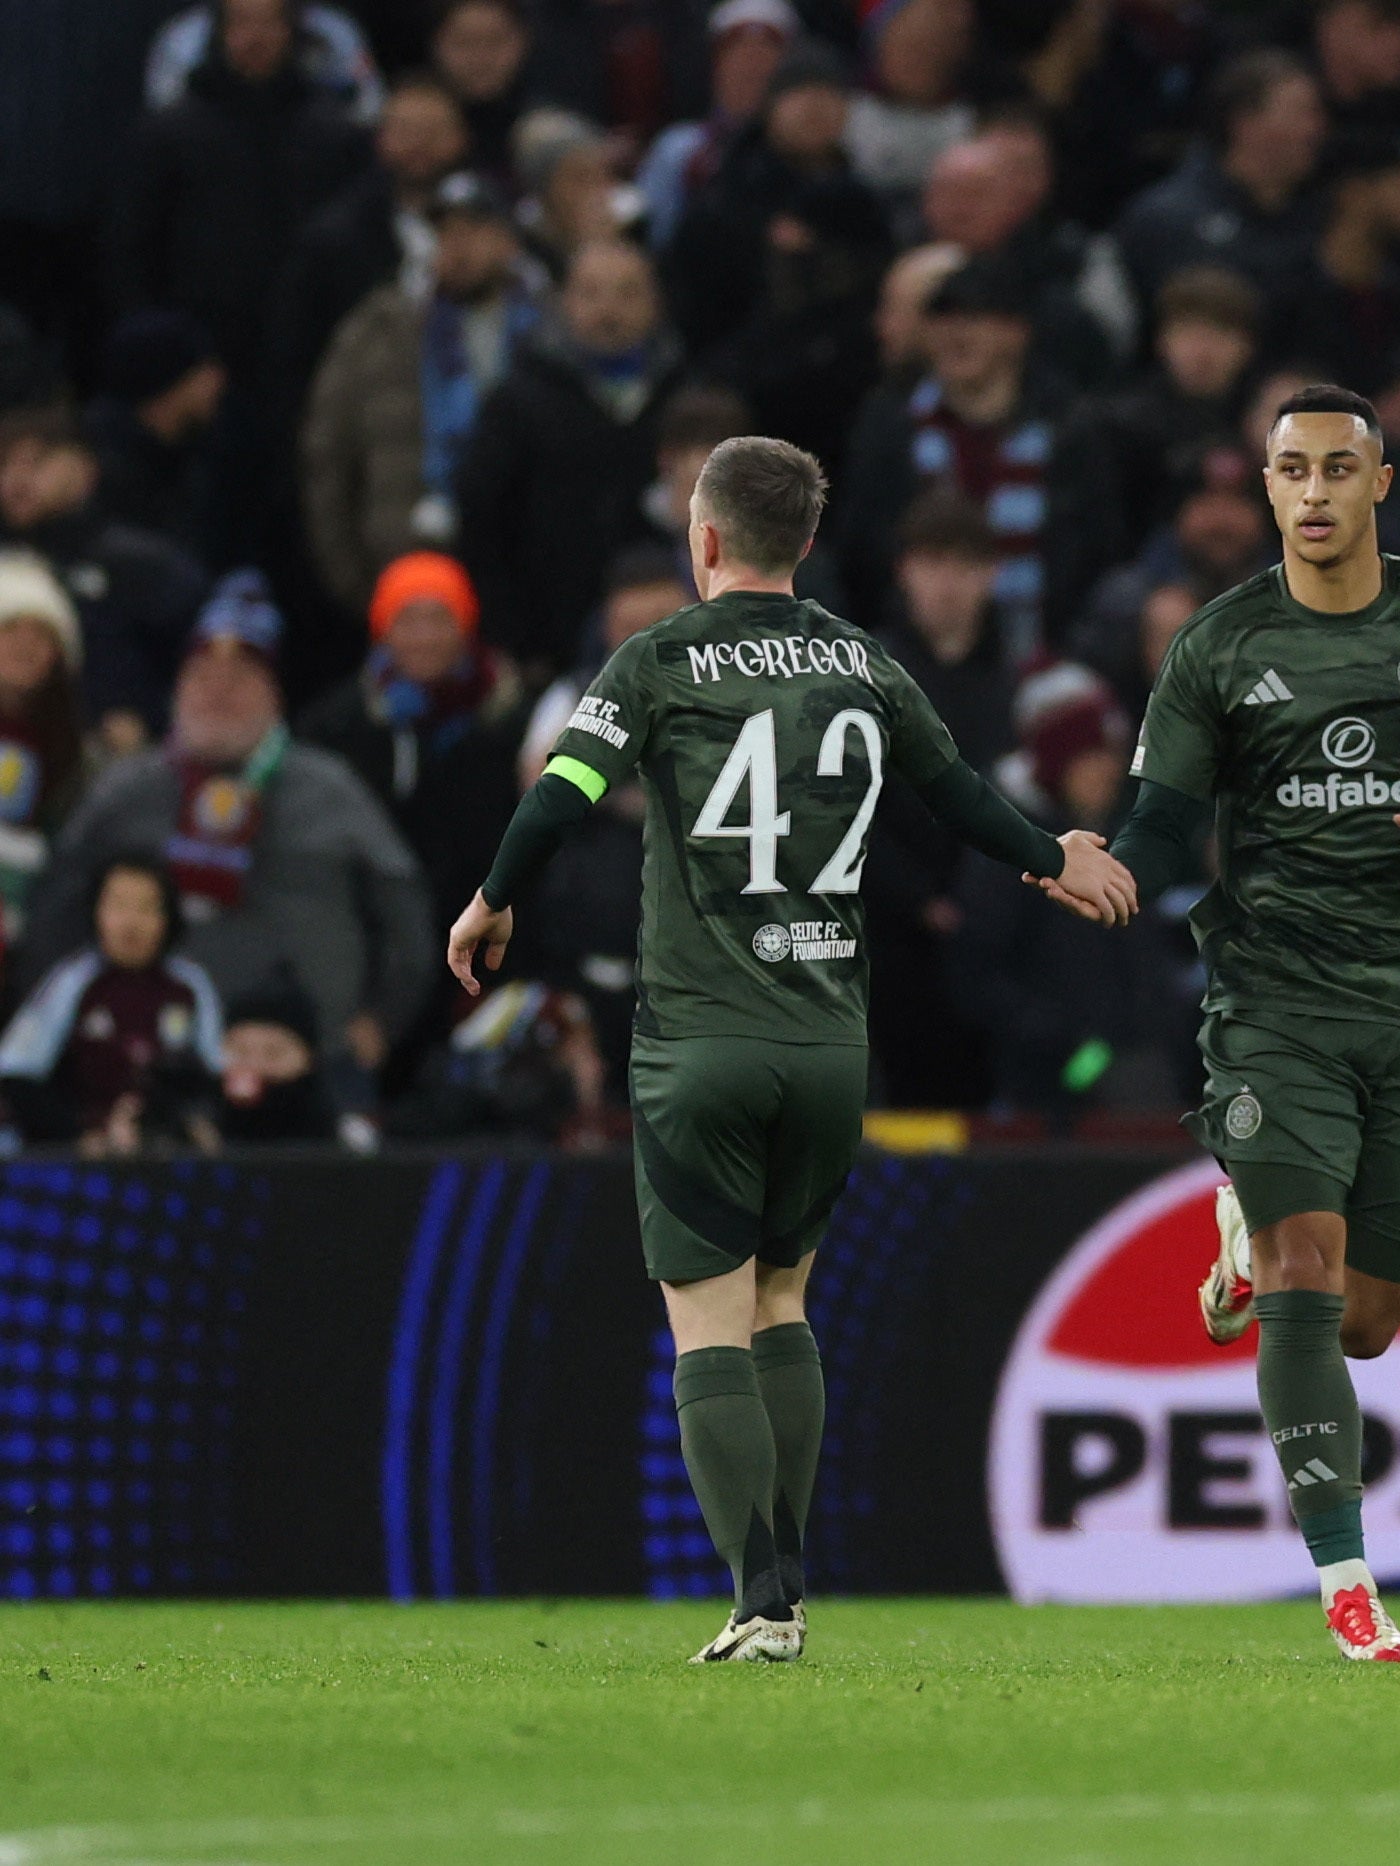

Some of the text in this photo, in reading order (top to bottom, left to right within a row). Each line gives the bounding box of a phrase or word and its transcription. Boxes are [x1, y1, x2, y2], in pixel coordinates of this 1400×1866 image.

[598, 700, 620, 721] FC
[690, 708, 884, 894] 42
[789, 921, 841, 941] CELTIC FC
[792, 939, 857, 962] FOUNDATION
[1272, 1421, 1338, 1445] CELTIC
